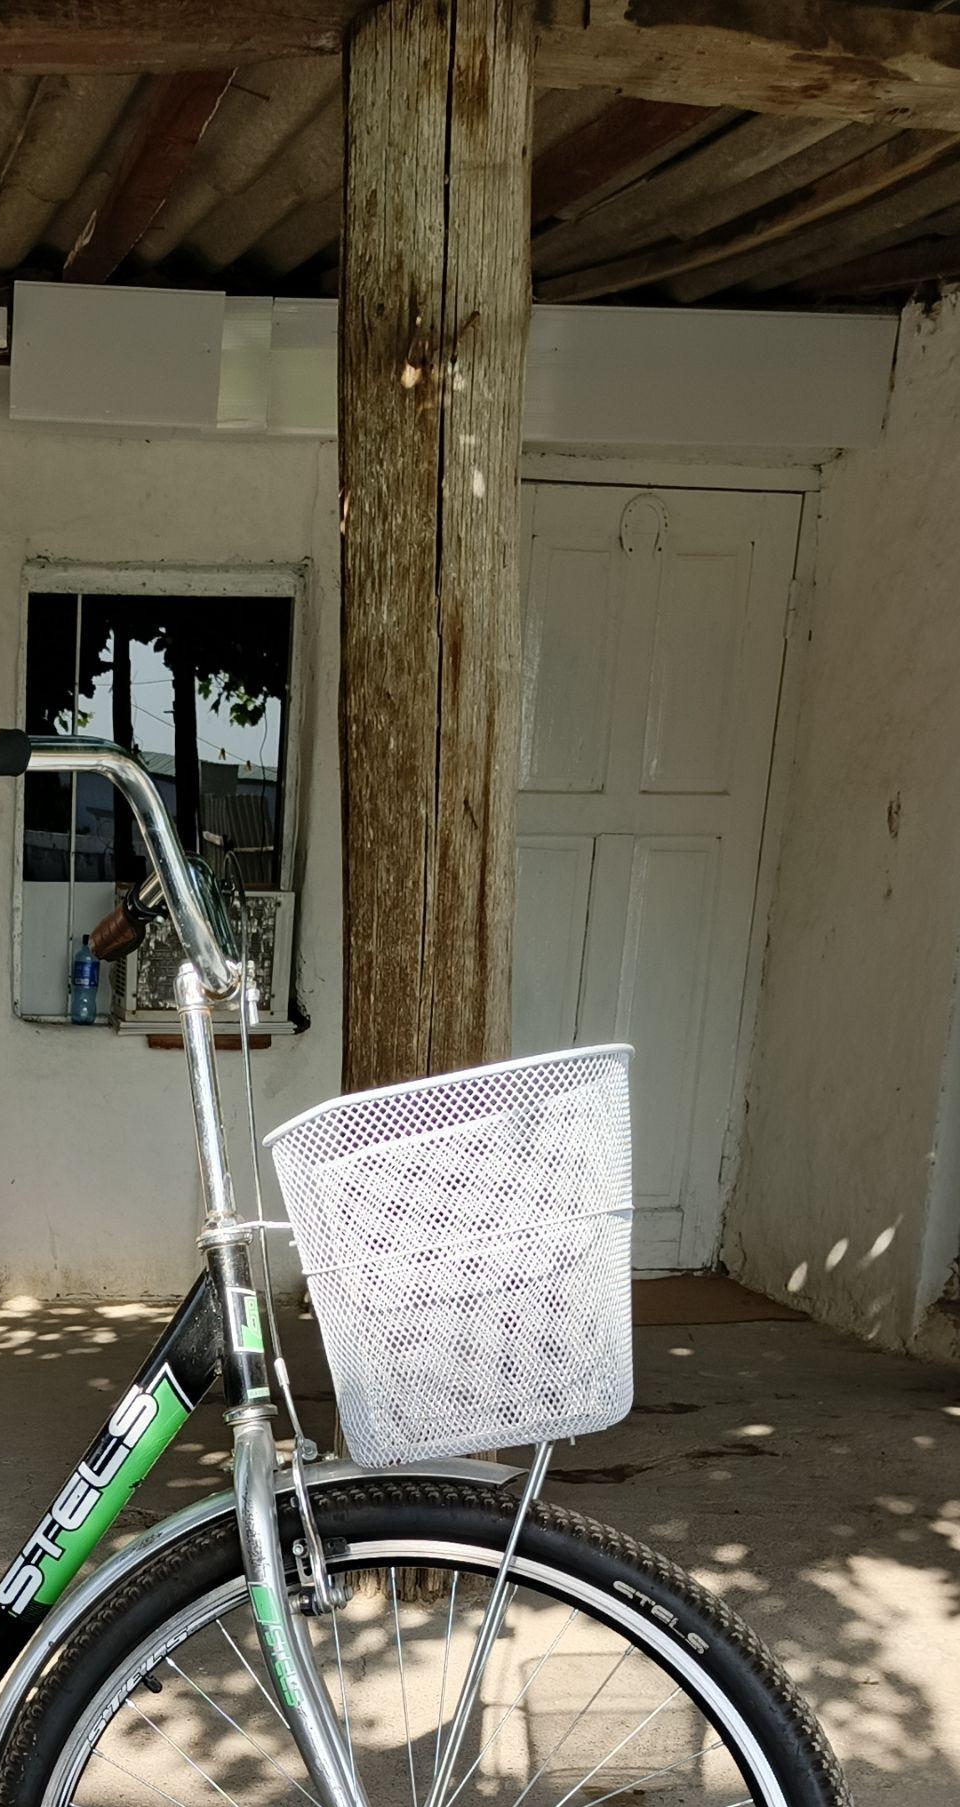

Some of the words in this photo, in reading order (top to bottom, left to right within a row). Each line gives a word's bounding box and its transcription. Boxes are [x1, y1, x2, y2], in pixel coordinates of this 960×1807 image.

[613, 1580, 709, 1655] STELS
[88, 1629, 189, 1743] STELS
[264, 1625, 304, 1708] STELS
